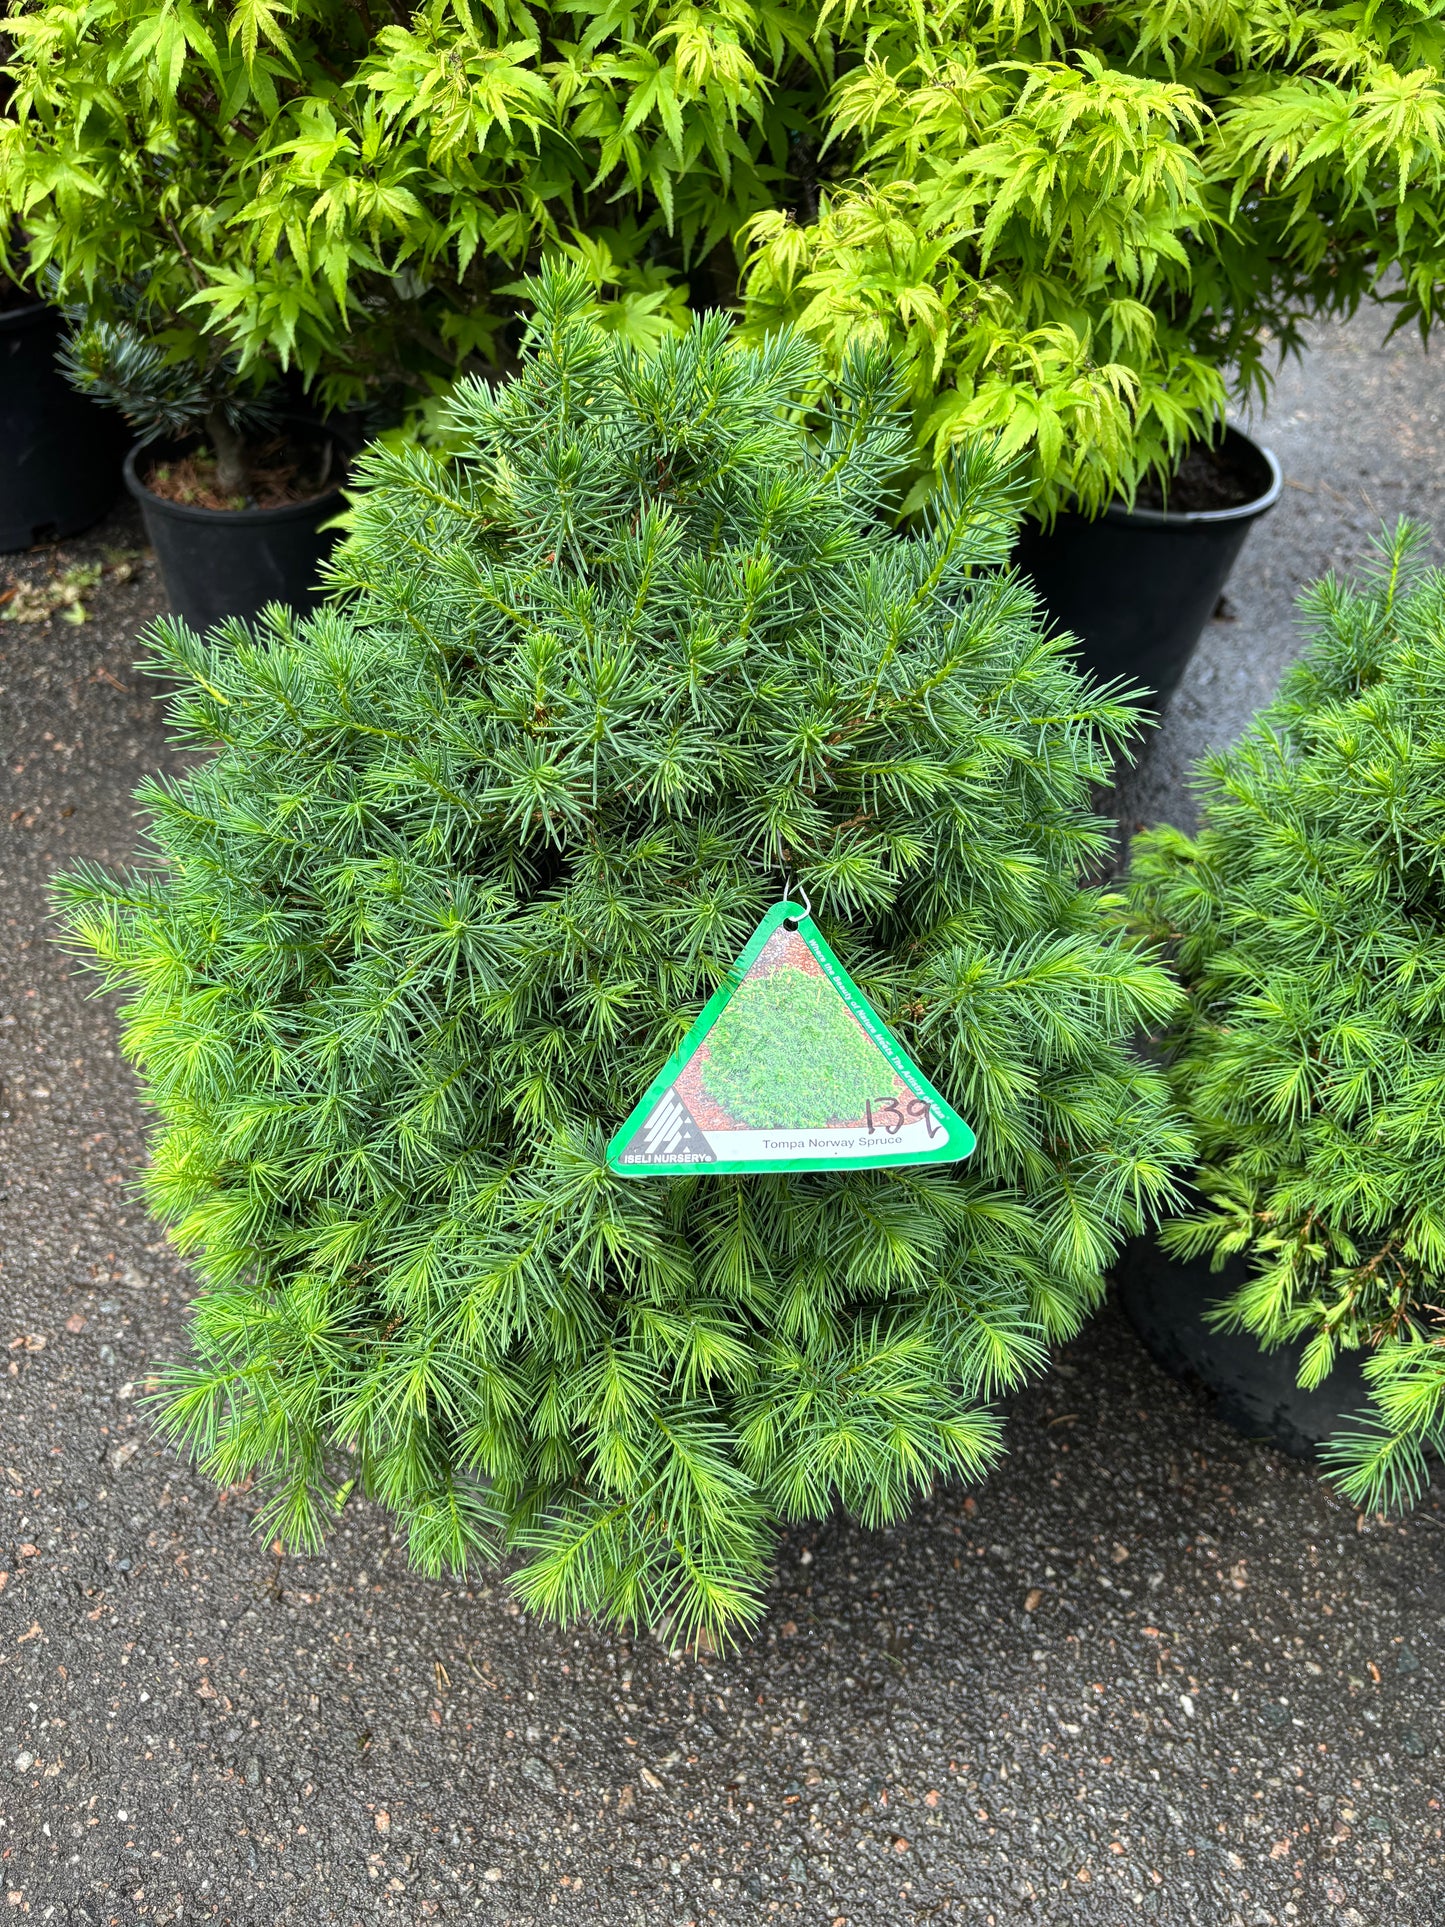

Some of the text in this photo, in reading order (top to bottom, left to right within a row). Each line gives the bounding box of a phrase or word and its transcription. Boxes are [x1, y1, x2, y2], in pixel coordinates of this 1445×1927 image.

[809, 939, 826, 963] Where
[825, 963, 835, 975] the
[833, 976, 852, 1000] Beauty
[850, 1000, 860, 1011] of
[857, 1009, 877, 1033] Nature
[875, 1034, 894, 1056] Meets
[892, 1055, 904, 1069] The
[902, 1070, 926, 1096] Artistry
[762, 1136, 902, 1150] Tompa Norway Spruce
[624, 1155, 652, 1164] ISELI
